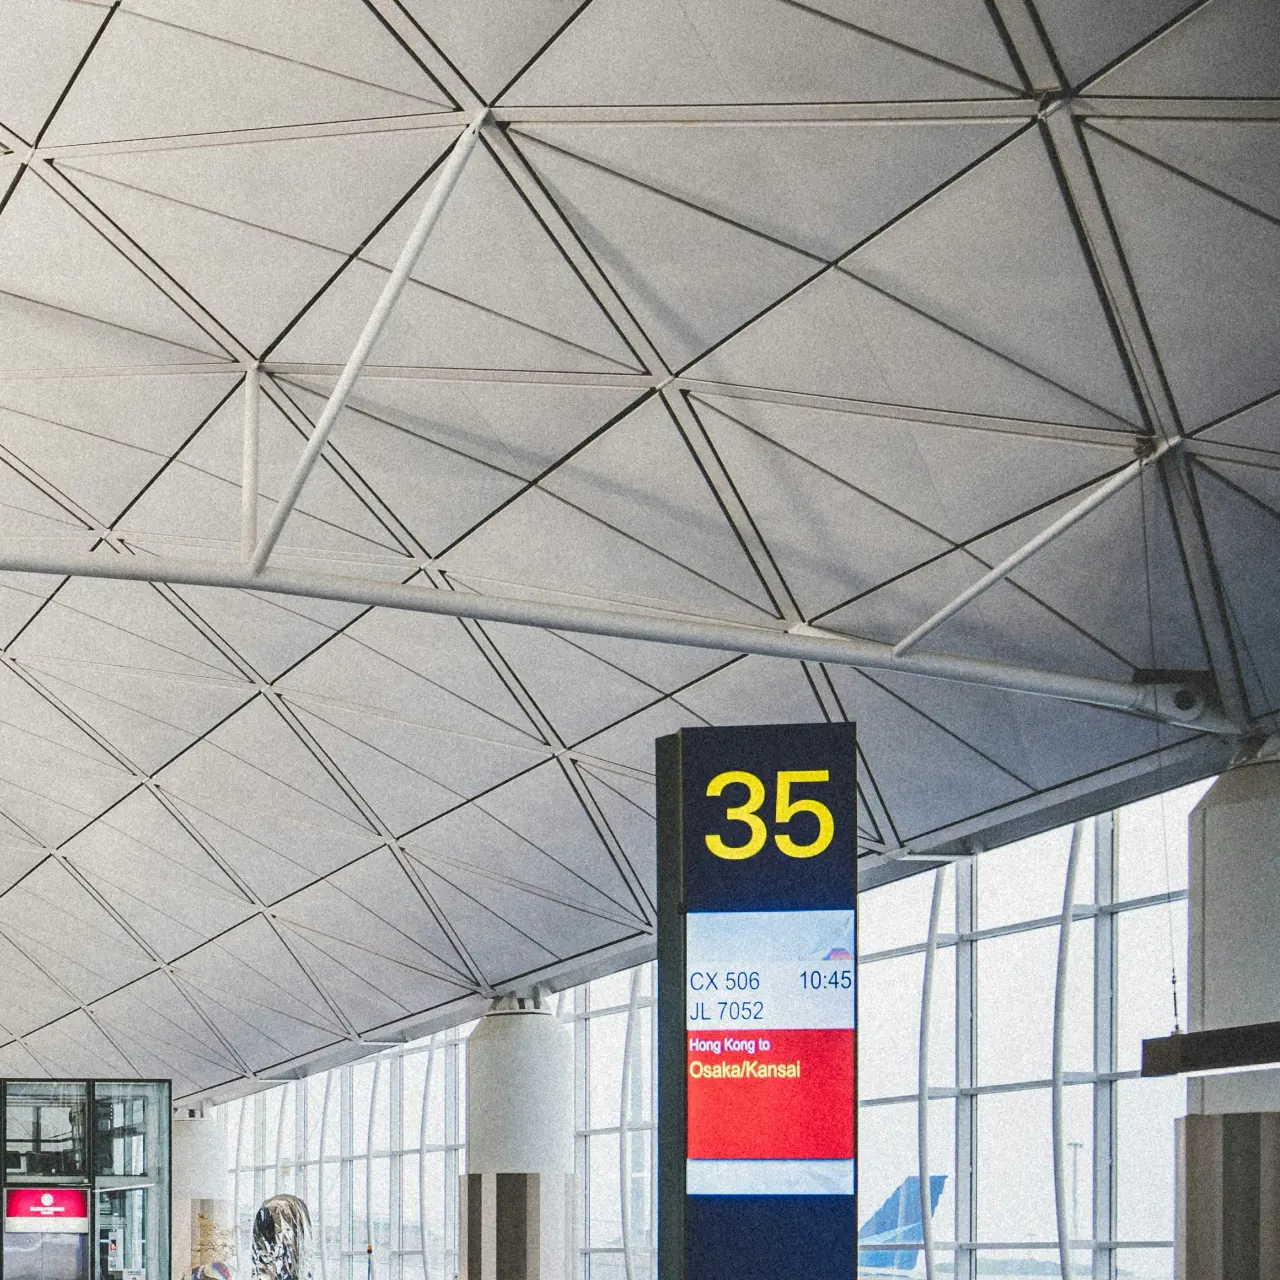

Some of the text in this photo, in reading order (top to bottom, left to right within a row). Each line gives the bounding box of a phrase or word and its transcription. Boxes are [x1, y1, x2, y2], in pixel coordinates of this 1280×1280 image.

[704, 769, 835, 861] 35
[690, 971, 760, 991] CX 506
[800, 970, 852, 989] 10:45
[690, 1001, 764, 1020] JL 7052
[689, 1037, 771, 1054] Hong Kong to
[689, 1059, 801, 1079] Osaka/Kansai
